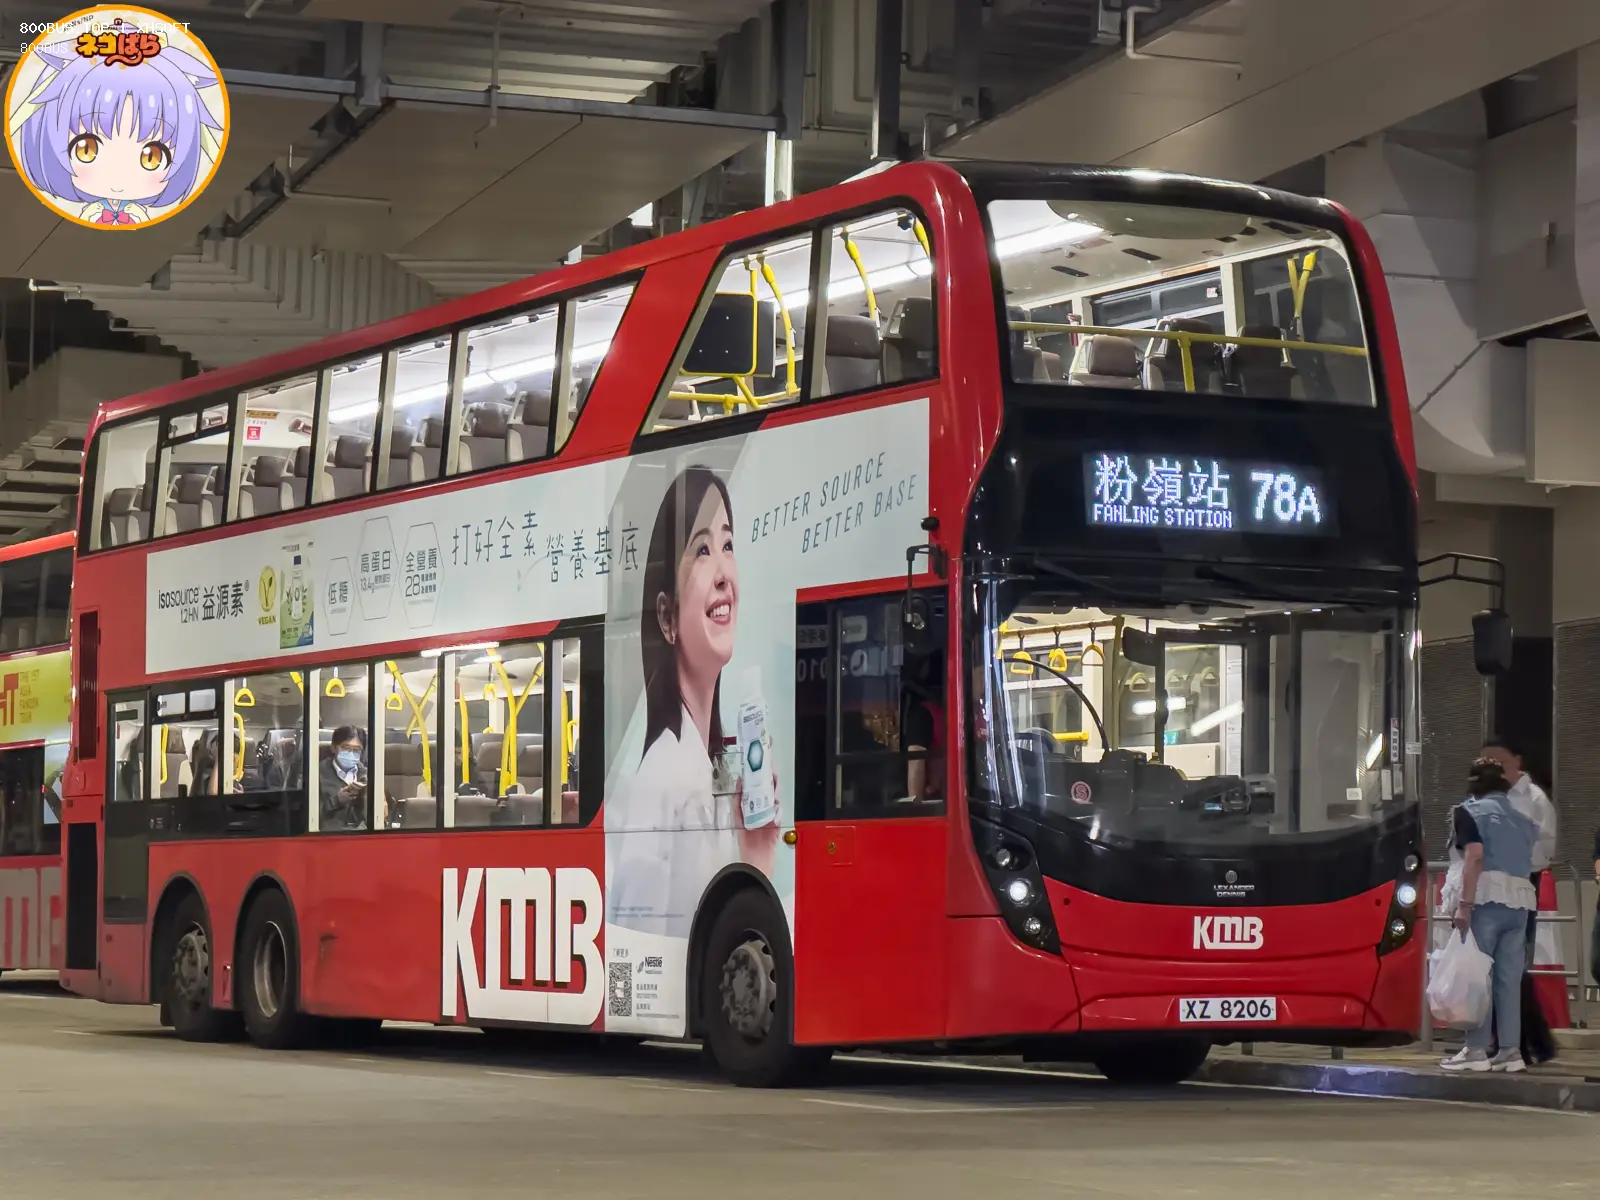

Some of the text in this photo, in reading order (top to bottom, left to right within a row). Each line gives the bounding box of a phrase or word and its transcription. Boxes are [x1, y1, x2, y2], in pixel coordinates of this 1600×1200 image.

[752, 452, 885, 543] BETTER SOURCE
[1094, 454, 1230, 509] 粉嶺站
[1250, 472, 1321, 523] 78A
[802, 474, 917, 553] BETTER BASE
[1093, 503, 1233, 529] FANLING STATION
[452, 510, 640, 583] 打好全素 營養基底
[158, 587, 200, 610] isosource
[405, 574, 421, 597] 28
[258, 615, 277, 625] VEGAN
[442, 867, 605, 1026] KMB
[1193, 916, 1264, 949] KMB
[1186, 1000, 1271, 1019] XZ 8206
